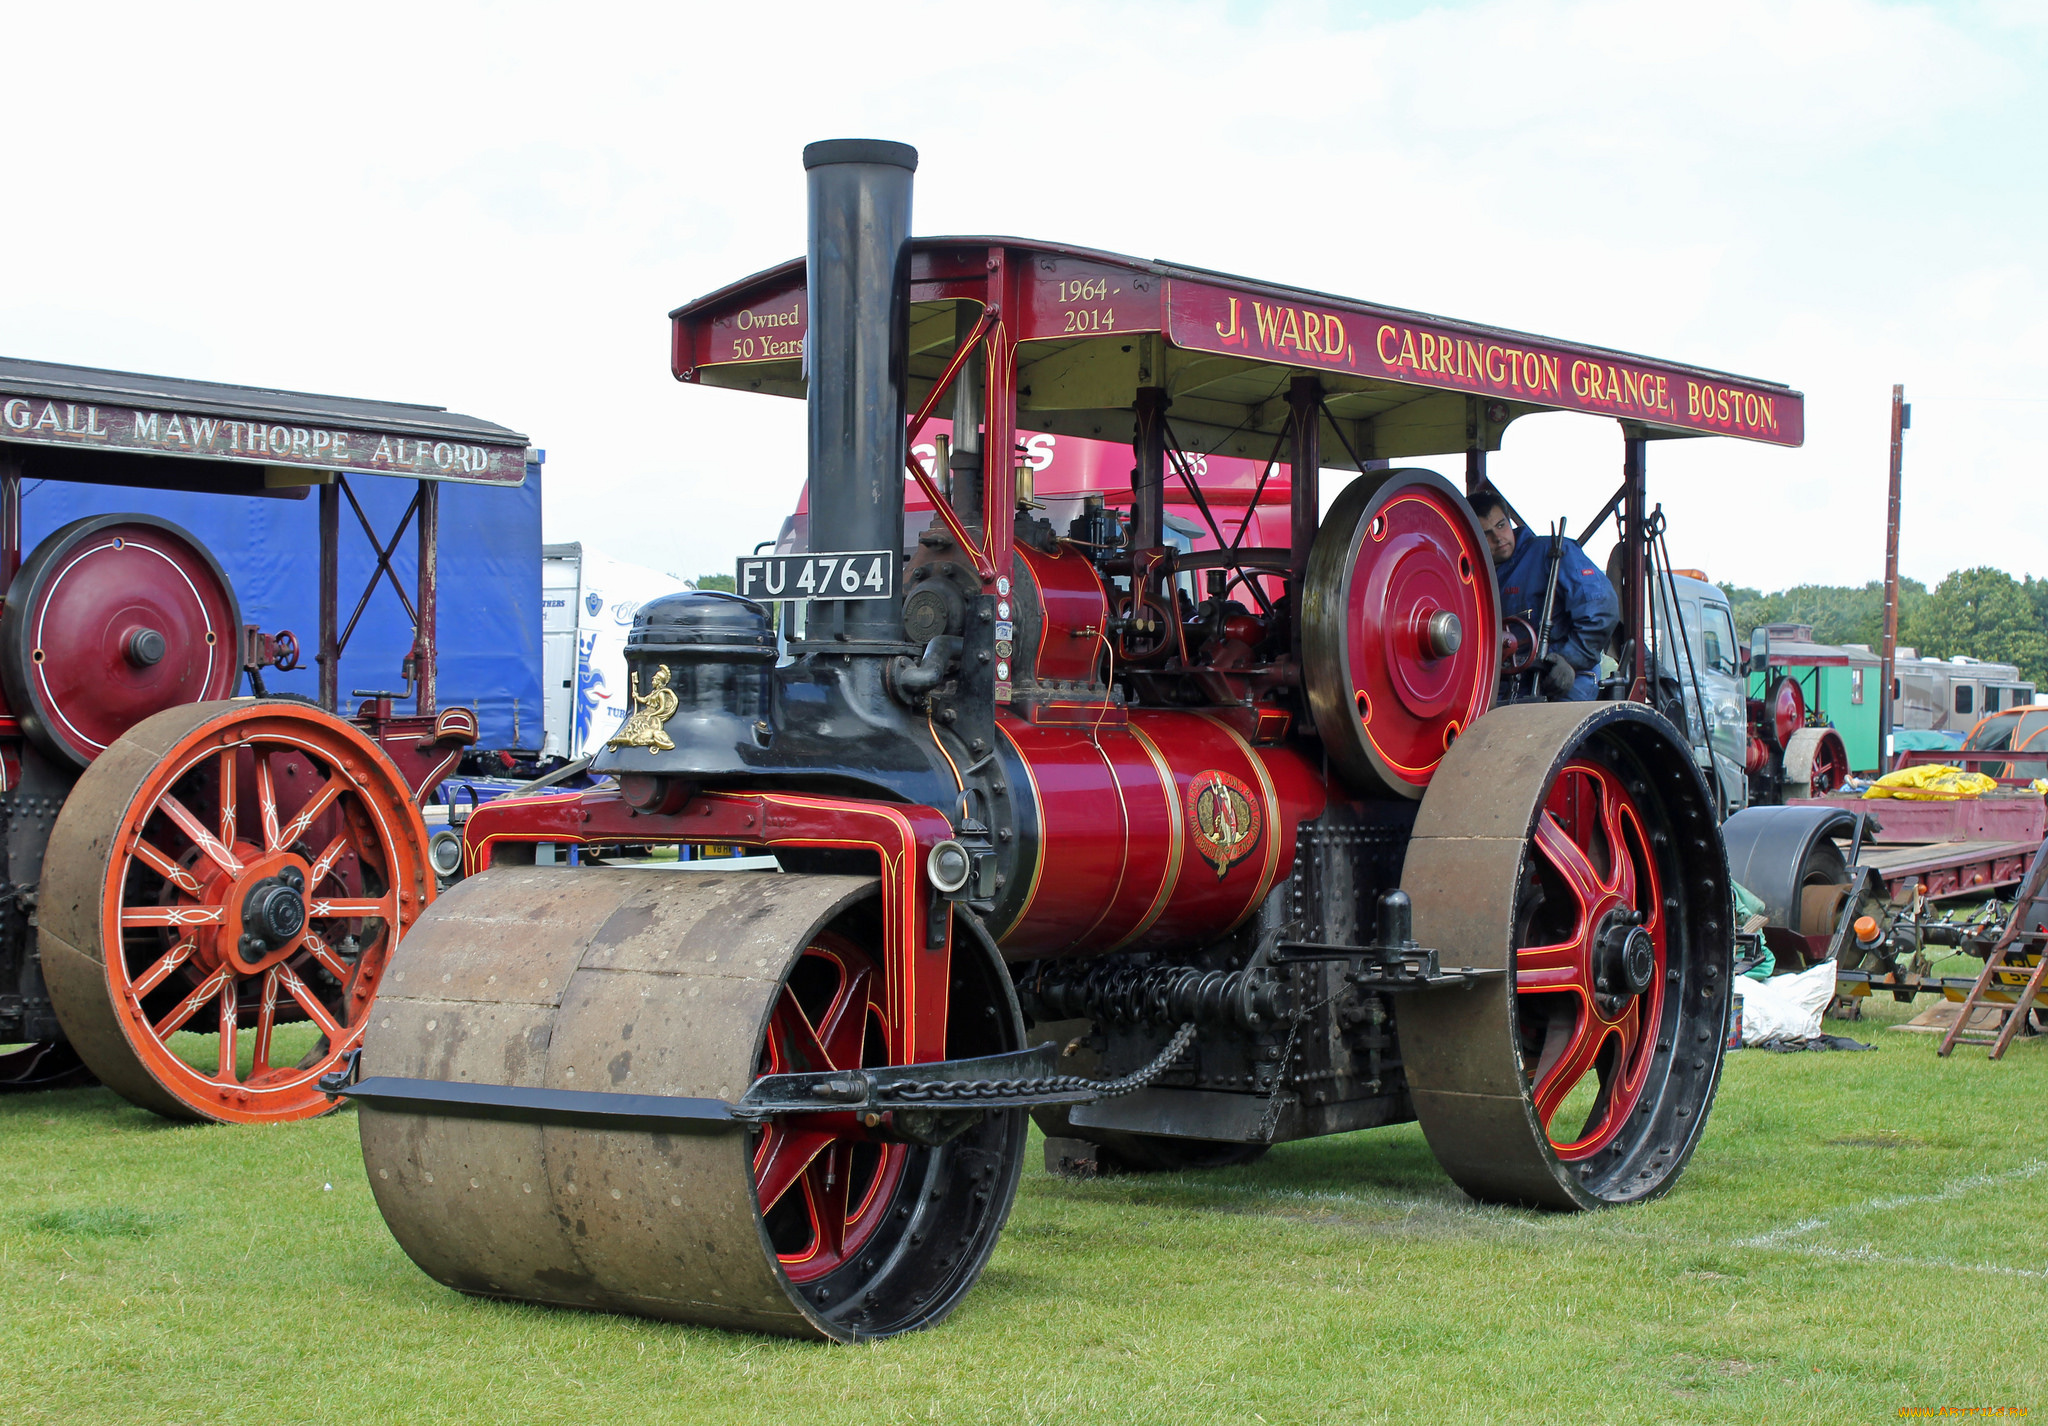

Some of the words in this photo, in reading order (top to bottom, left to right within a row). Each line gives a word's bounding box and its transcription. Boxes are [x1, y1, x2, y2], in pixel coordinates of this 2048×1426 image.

[1058, 277, 1108, 303] 1964
[736, 303, 800, 331] Owned
[1063, 307, 1115, 332] 2014
[731, 338, 755, 360] 50
[758, 335, 804, 357] Years
[1215, 296, 1246, 341] J.
[1251, 301, 1354, 363] WARD,
[1376, 324, 1560, 394] CARRINGTON
[1571, 359, 1676, 416] GRANGE,
[1686, 380, 1779, 429] BOSTON.
[133, 410, 351, 461] MAWTHORPE
[369, 433, 492, 474] ALFORD
[742, 560, 787, 596] FU
[795, 557, 885, 594] 4764
